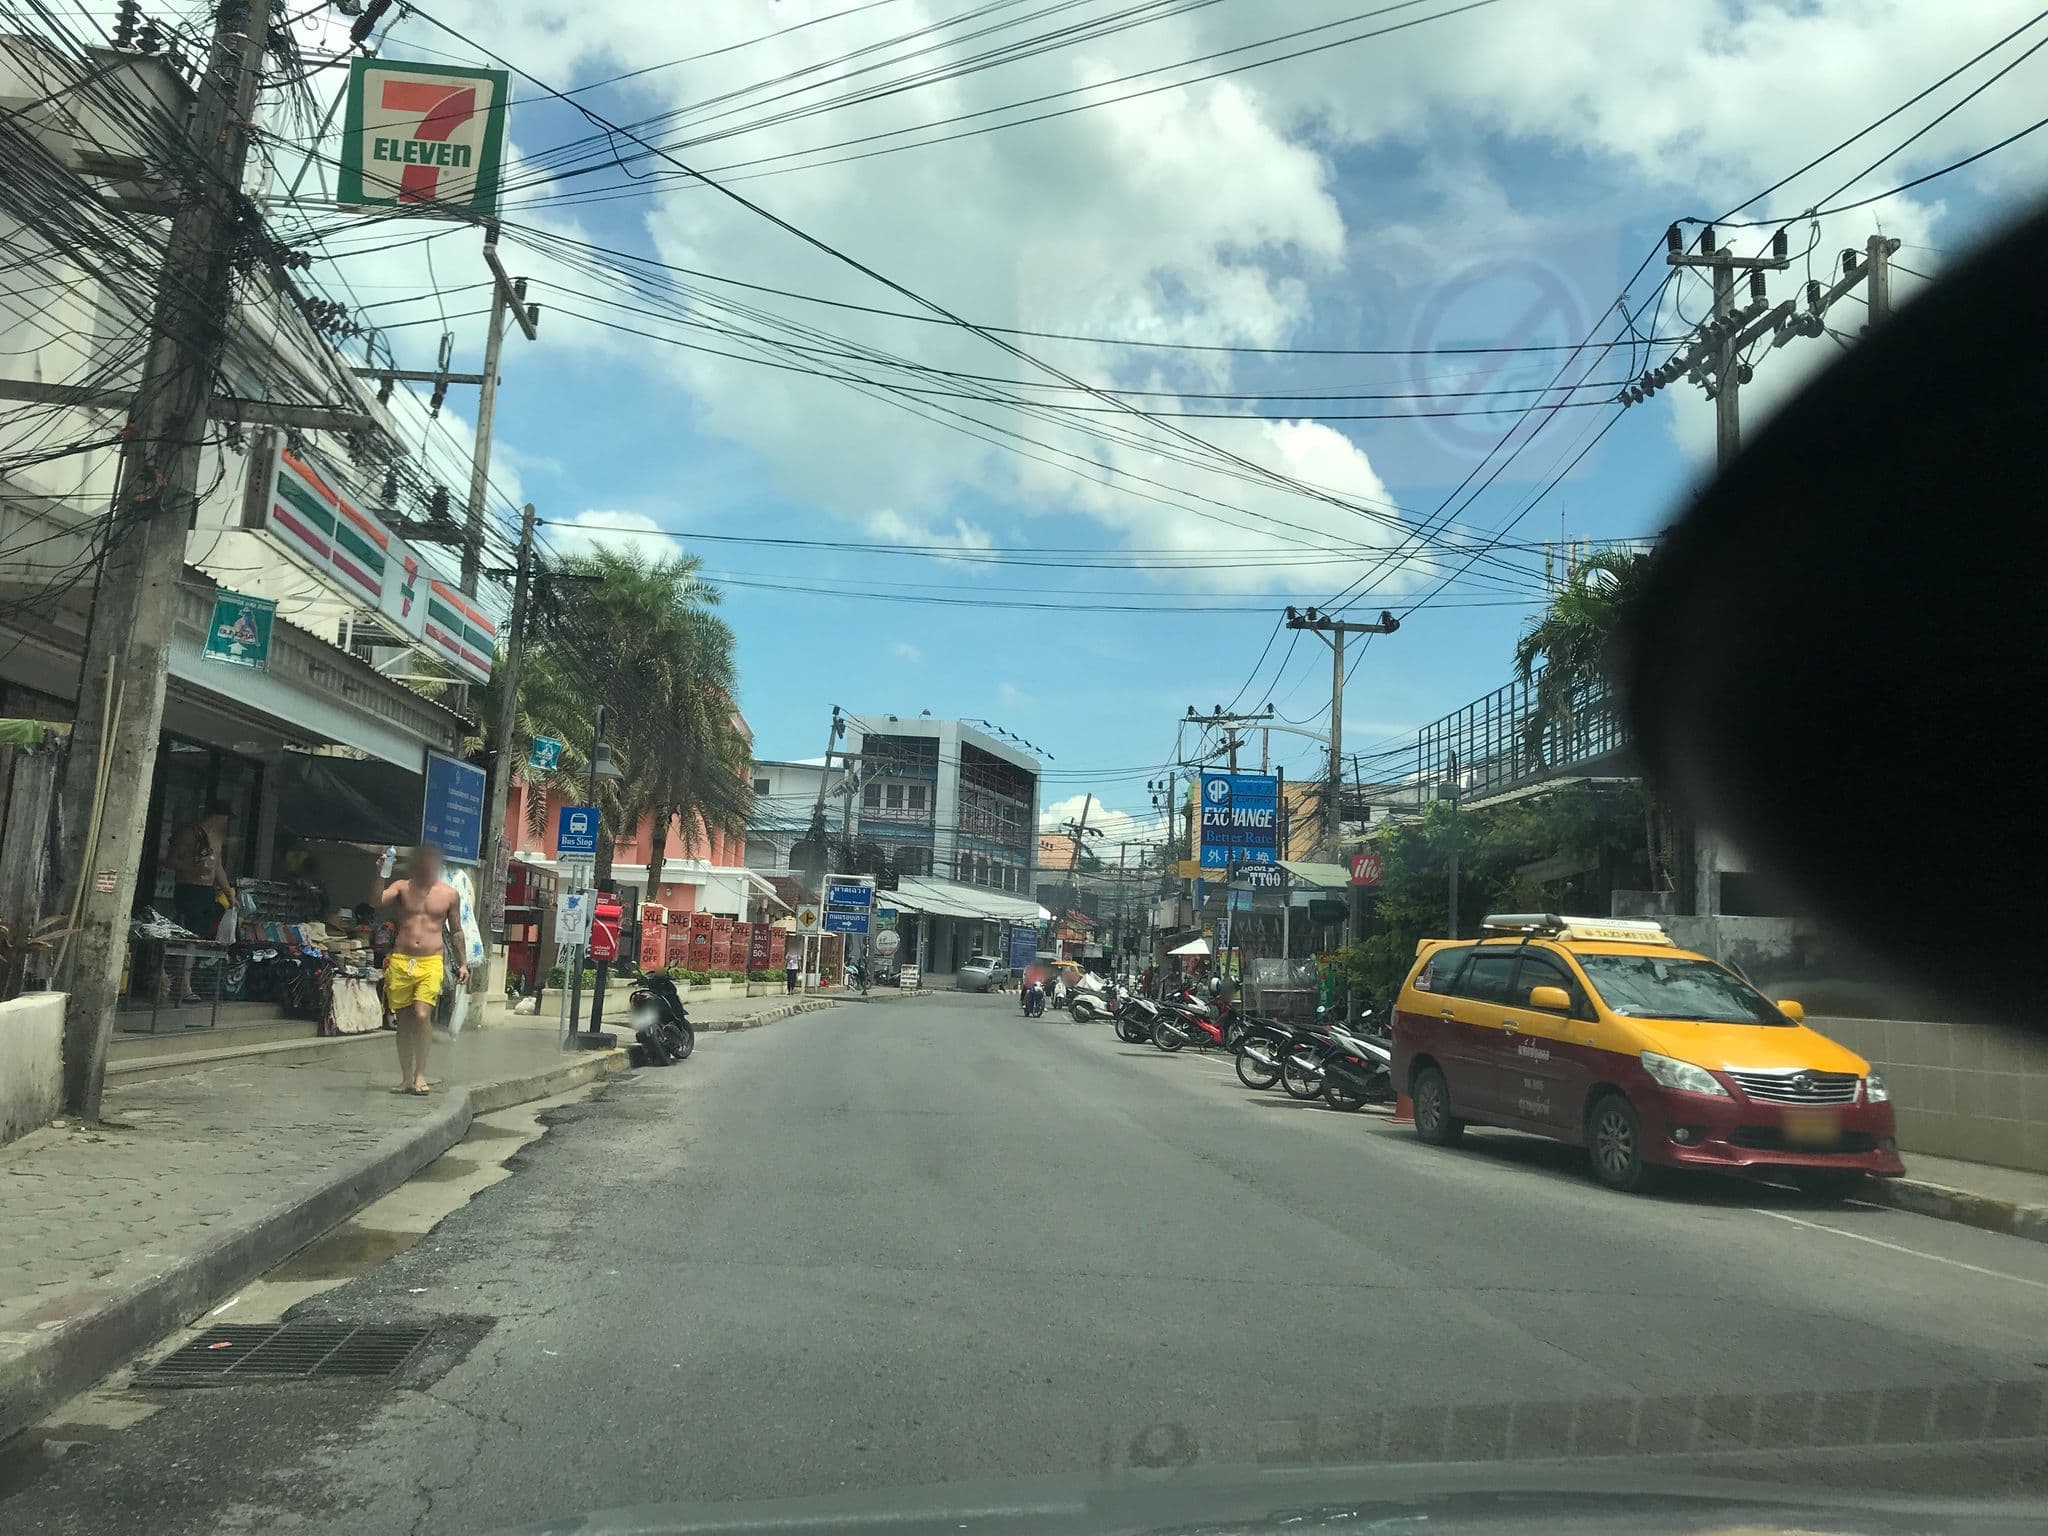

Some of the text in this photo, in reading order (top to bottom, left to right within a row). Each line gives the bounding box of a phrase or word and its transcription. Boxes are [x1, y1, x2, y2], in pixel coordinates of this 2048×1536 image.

[381, 80, 476, 203] 7
[1203, 807, 1274, 828] EXCHANGE
[561, 836, 593, 847] Bus Stop
[1354, 858, 1382, 883] illy
[670, 914, 688, 927] SALE
